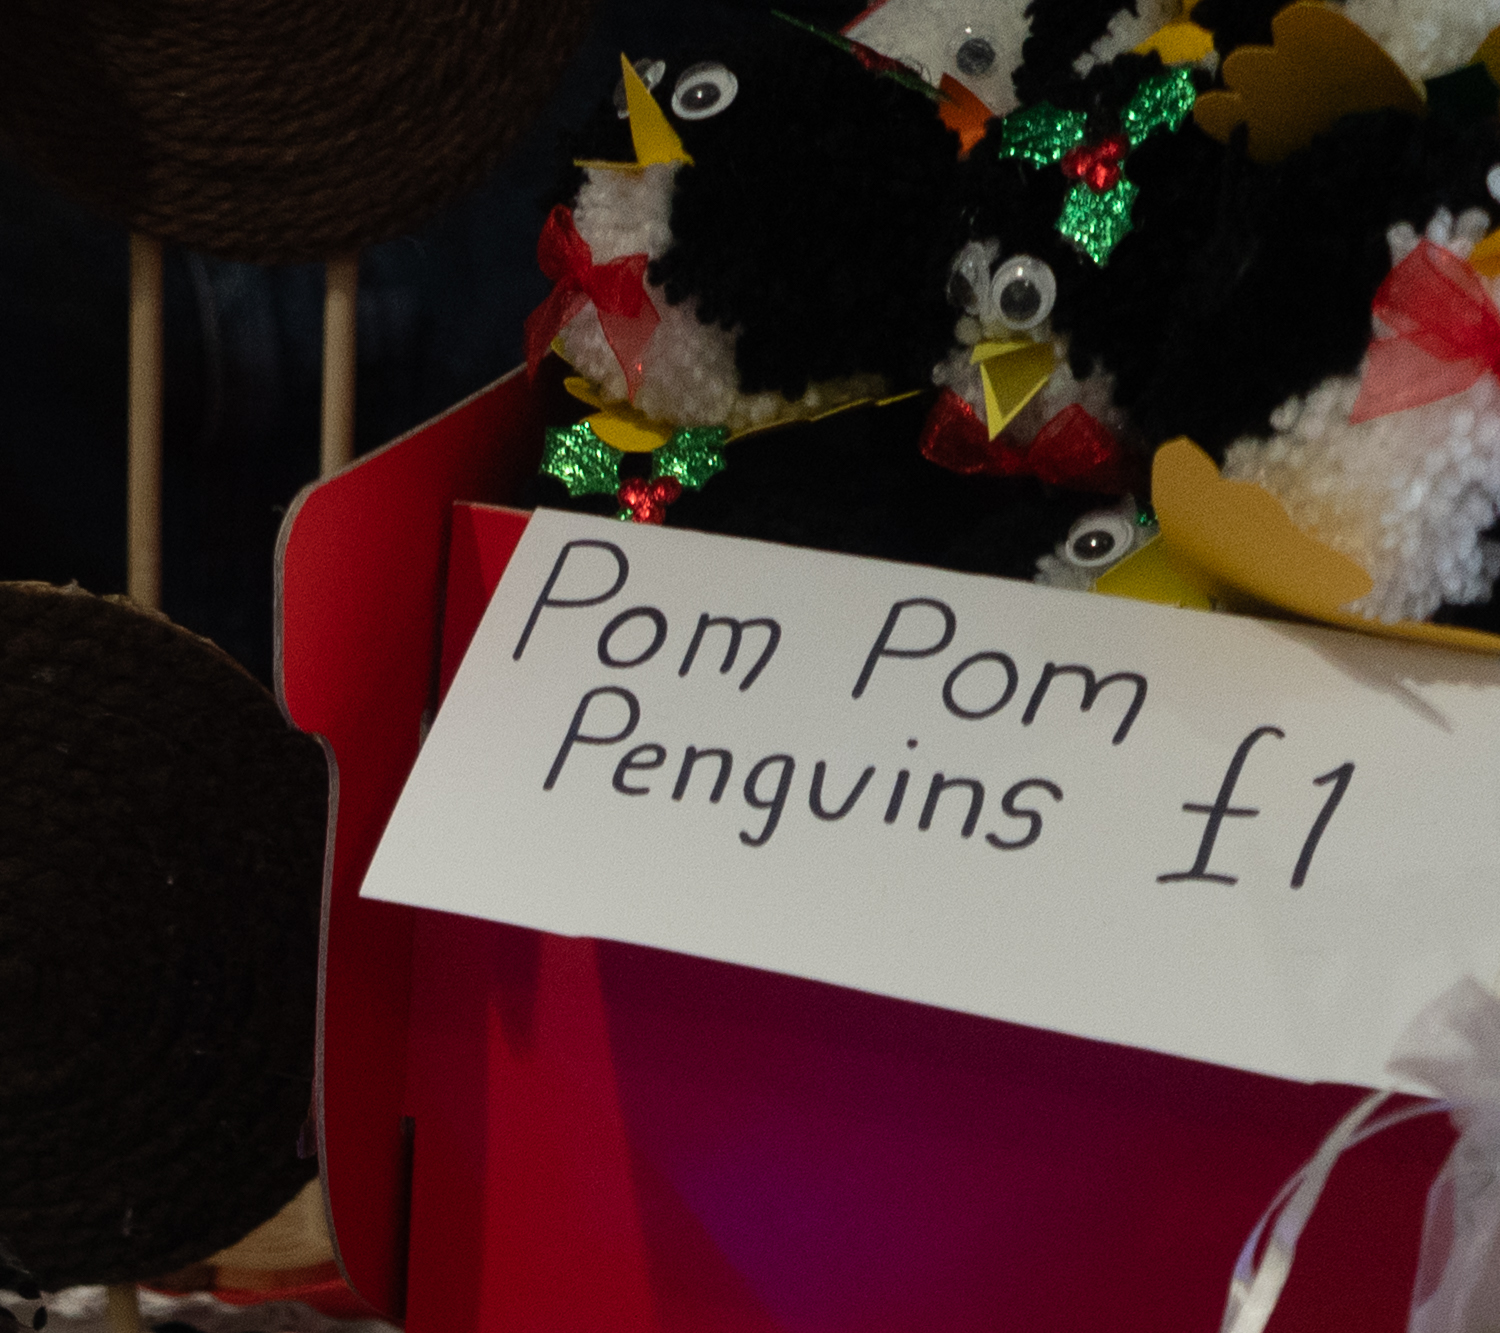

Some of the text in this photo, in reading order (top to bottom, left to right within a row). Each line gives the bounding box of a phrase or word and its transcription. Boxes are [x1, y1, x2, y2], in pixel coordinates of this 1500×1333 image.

[510, 538, 1151, 747] Pom Pom
[541, 684, 1357, 891] Penguins £1
